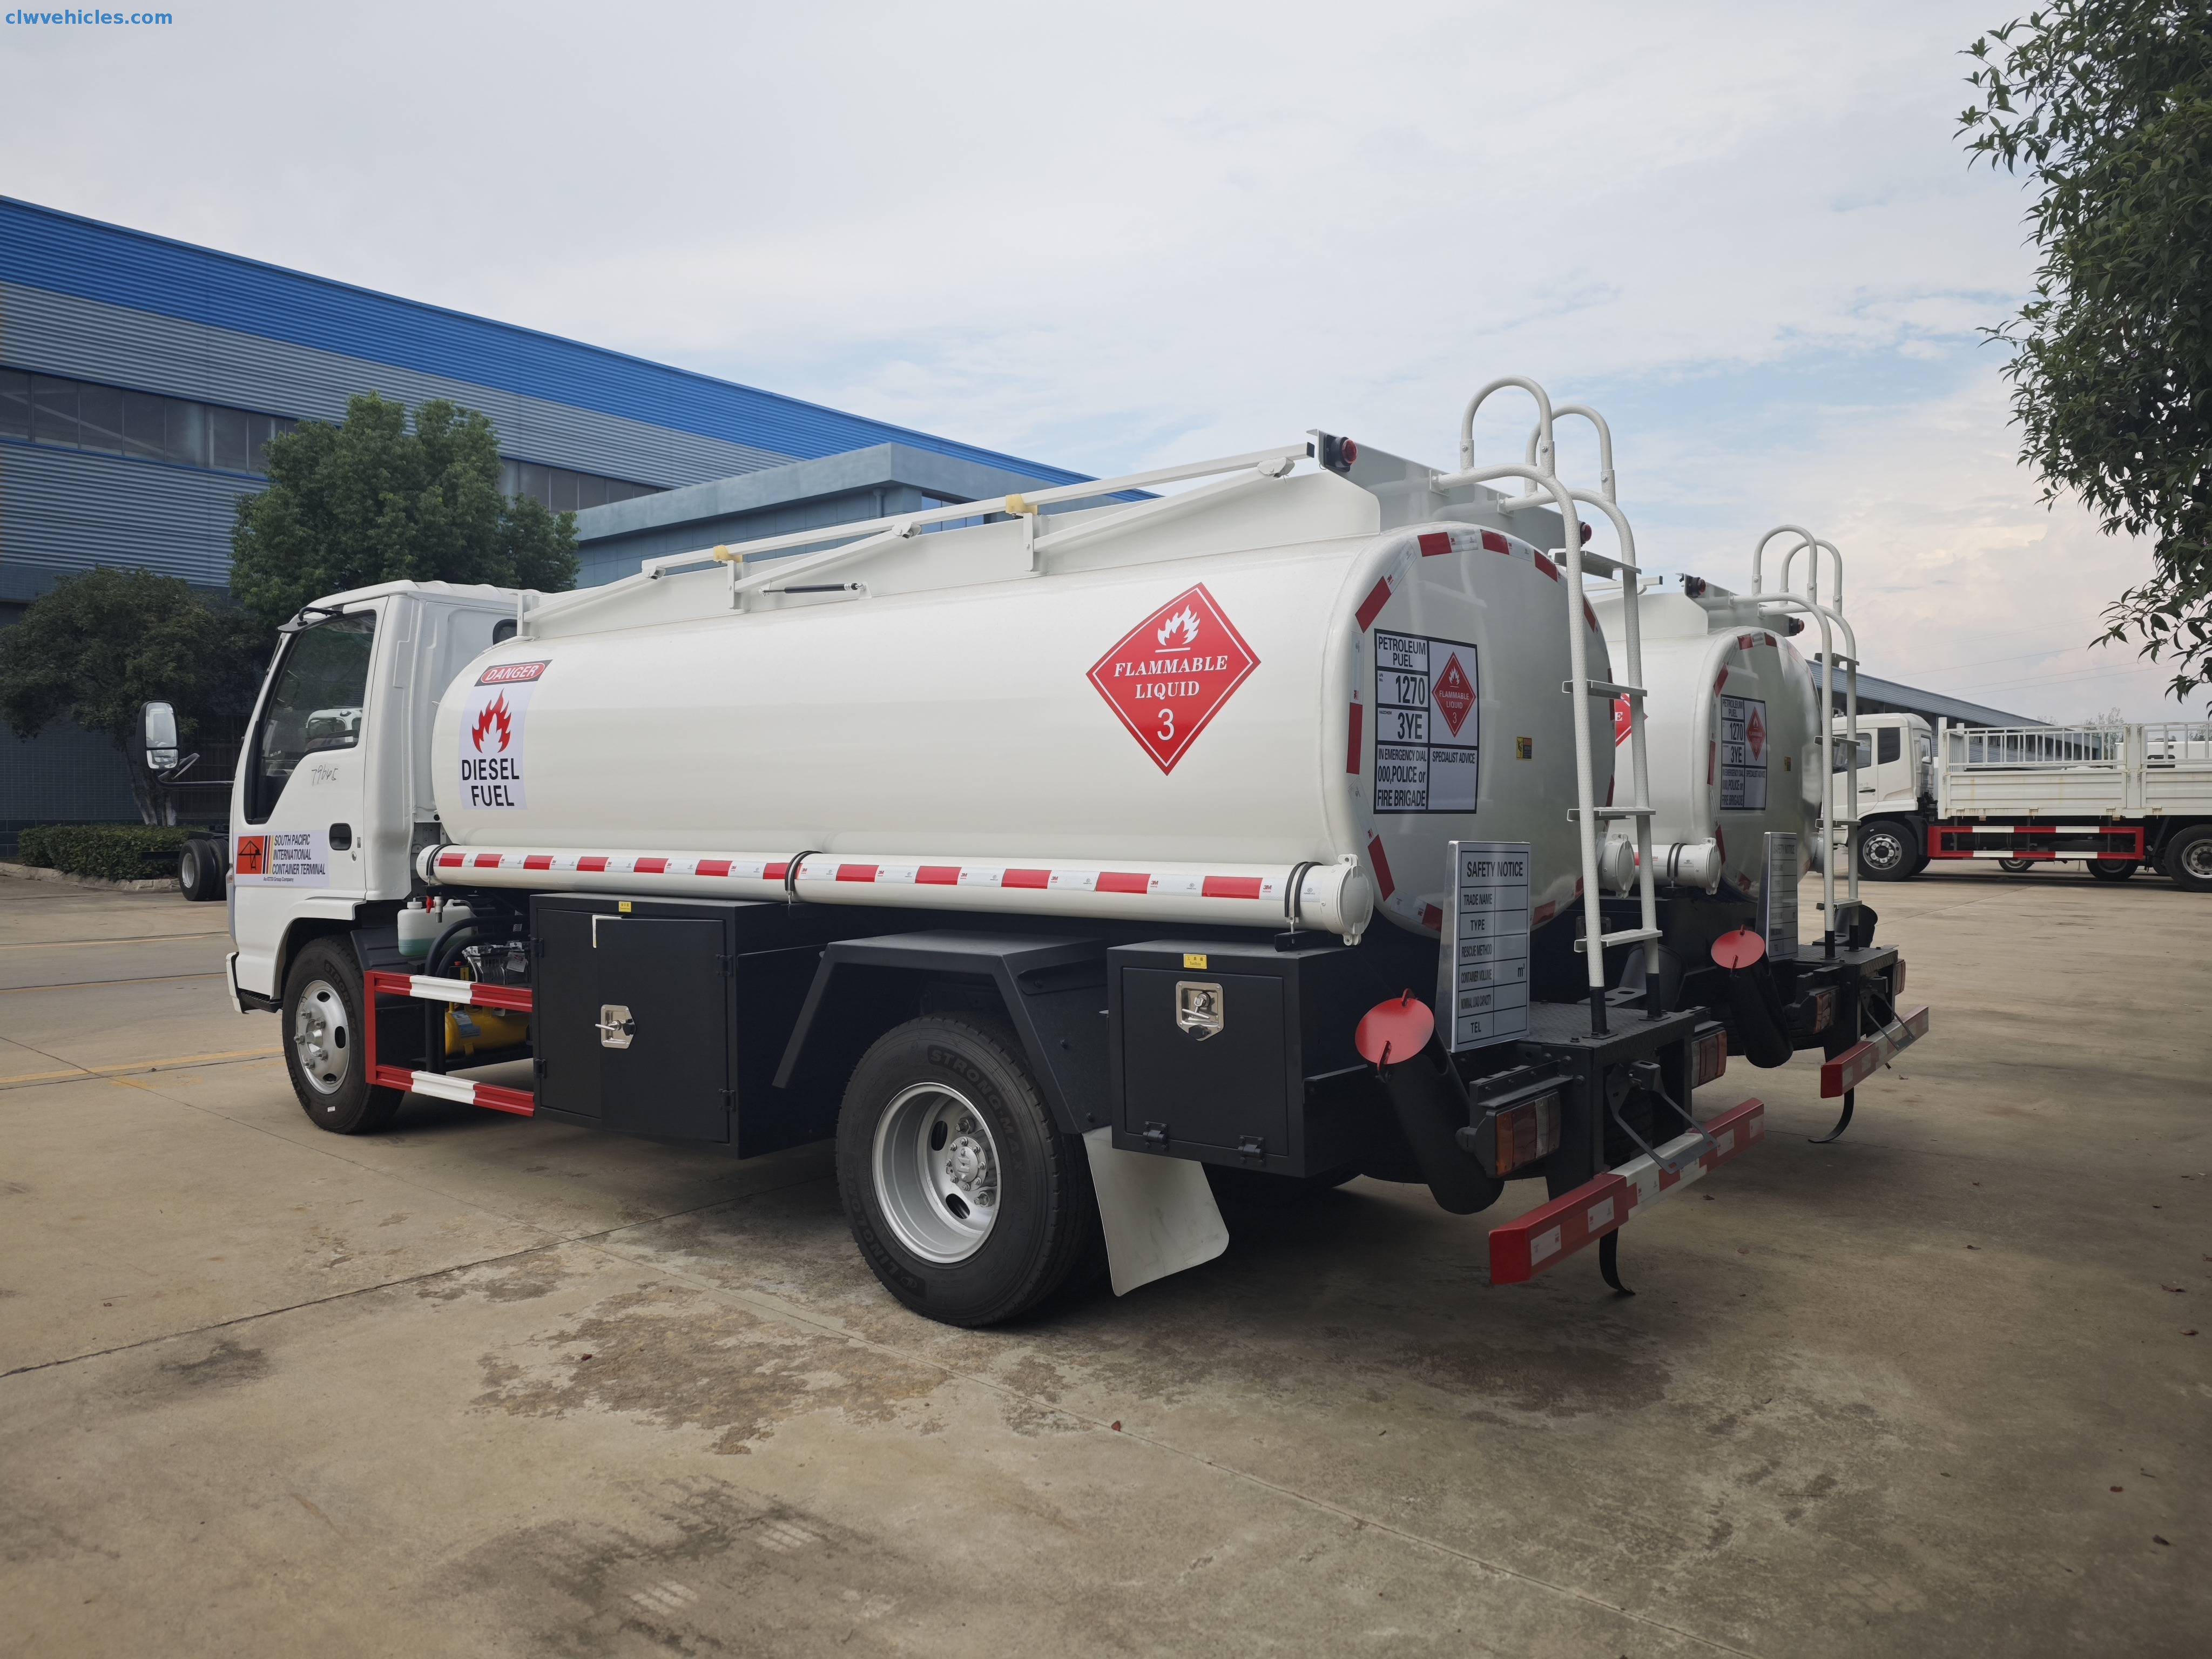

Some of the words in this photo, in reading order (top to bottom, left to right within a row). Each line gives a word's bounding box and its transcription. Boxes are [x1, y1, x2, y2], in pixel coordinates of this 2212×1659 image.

[1378, 636, 1426, 656] PETROLEUM
[485, 665, 539, 681] DANGER
[1113, 655, 1228, 677] FLAMMABLE
[1135, 680, 1200, 700] LIQUID
[1395, 675, 1425, 705] 1270
[1439, 690, 1469, 701] FLAMMABLE
[1446, 700, 1463, 709] LIQUID
[1157, 708, 1175, 740] 3
[1452, 712, 1457, 724] 3
[1397, 712, 1422, 739] 3YE
[1730, 723, 1743, 740] 1270
[1378, 748, 1384, 760] IN
[1385, 748, 1415, 761] EMERGENCY
[1416, 750, 1427, 761] DIAL
[1432, 751, 1459, 763] SPECIALIST
[1459, 752, 1475, 764] ADVICE
[1730, 746, 1742, 763] 3YE
[462, 758, 520, 781] DIESEL
[1418, 771, 1426, 783] or
[471, 785, 515, 806] FUEL
[1377, 790, 1393, 806] FIRE
[1394, 790, 1426, 807] BRIGADE
[274, 834, 292, 846] SOUTH
[292, 834, 311, 845] PACIFIC
[273, 849, 311, 860] INTERNATIONAL
[272, 864, 300, 875] CONTAINER
[300, 864, 325, 875] TERMINAL
[1467, 861, 1495, 878] SAFETY
[1497, 861, 1523, 877] NOTICE
[1464, 894, 1478, 905] TRADE
[1479, 894, 1492, 905] NAME
[1470, 919, 1485, 930] TYPE
[1461, 945, 1476, 957] RESCUE
[1477, 944, 1492, 956] METHOD
[1471, 1022, 1481, 1034] TEL
